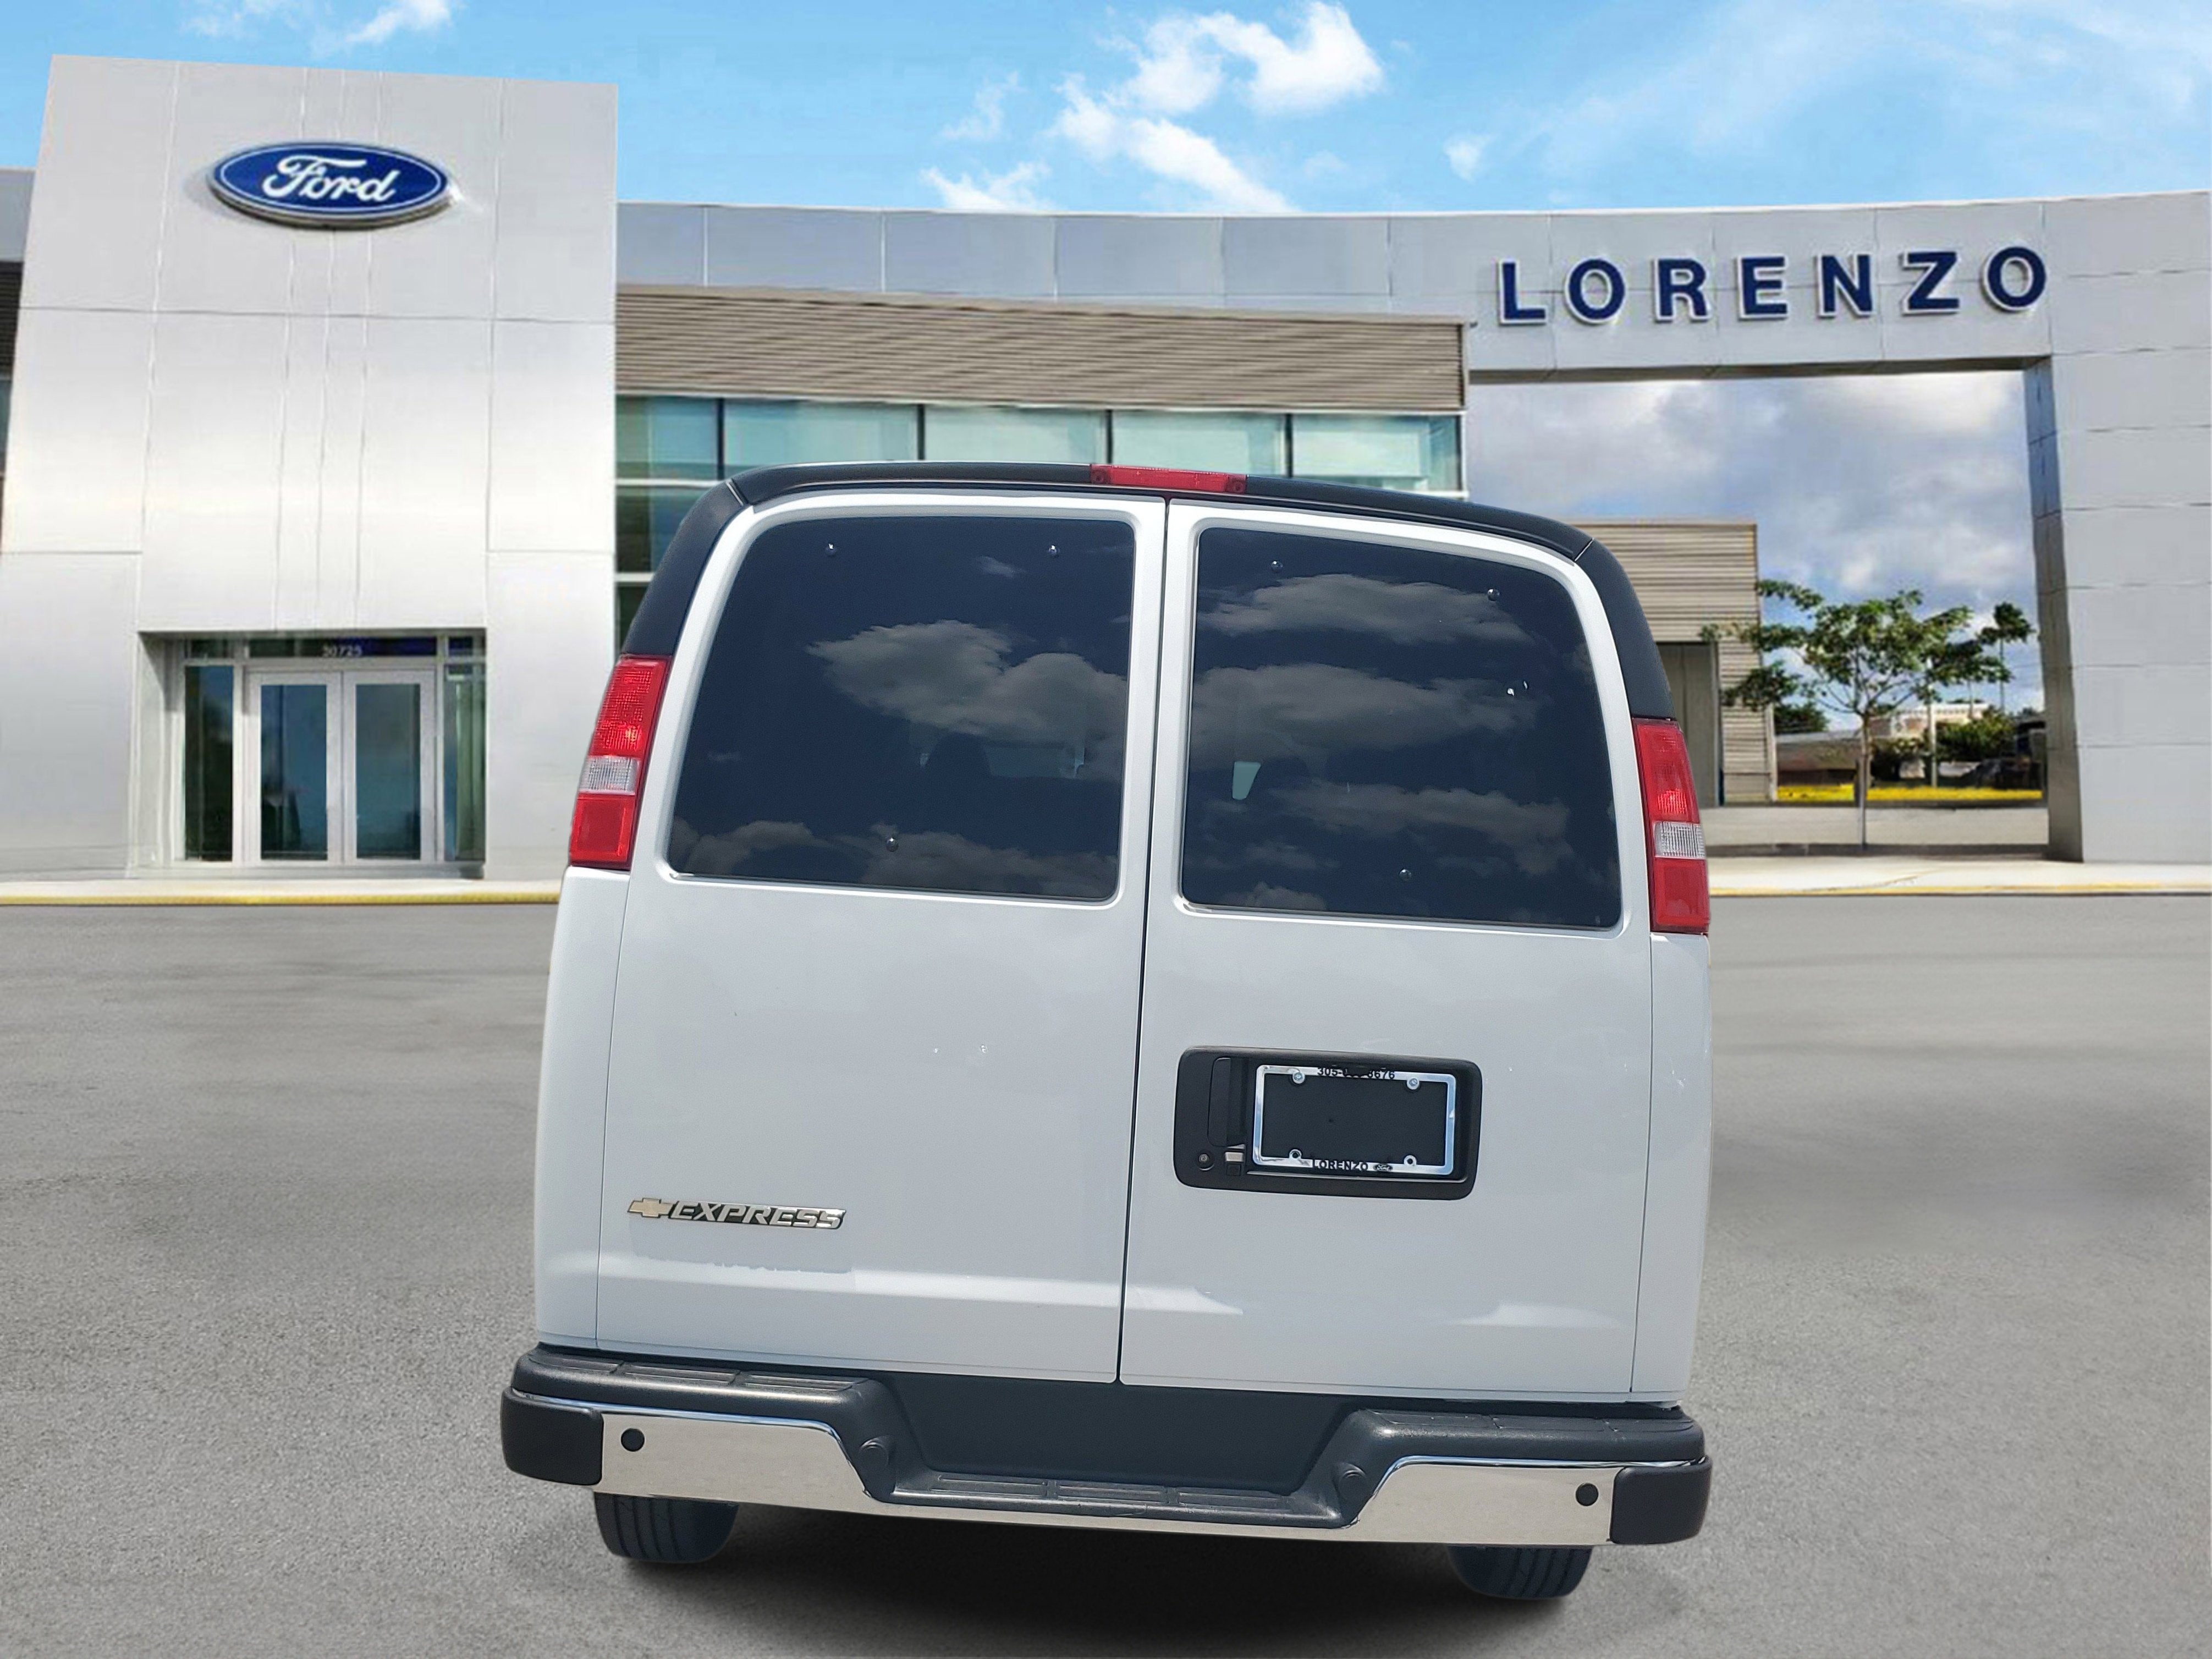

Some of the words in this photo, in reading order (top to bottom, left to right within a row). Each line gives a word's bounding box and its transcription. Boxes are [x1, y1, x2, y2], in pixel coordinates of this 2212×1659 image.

[262, 155, 400, 201] Ford
[1499, 246, 2047, 323] LORENZO
[1312, 1158, 1368, 1171] LORENZO
[669, 1200, 846, 1229] EXPRESS
